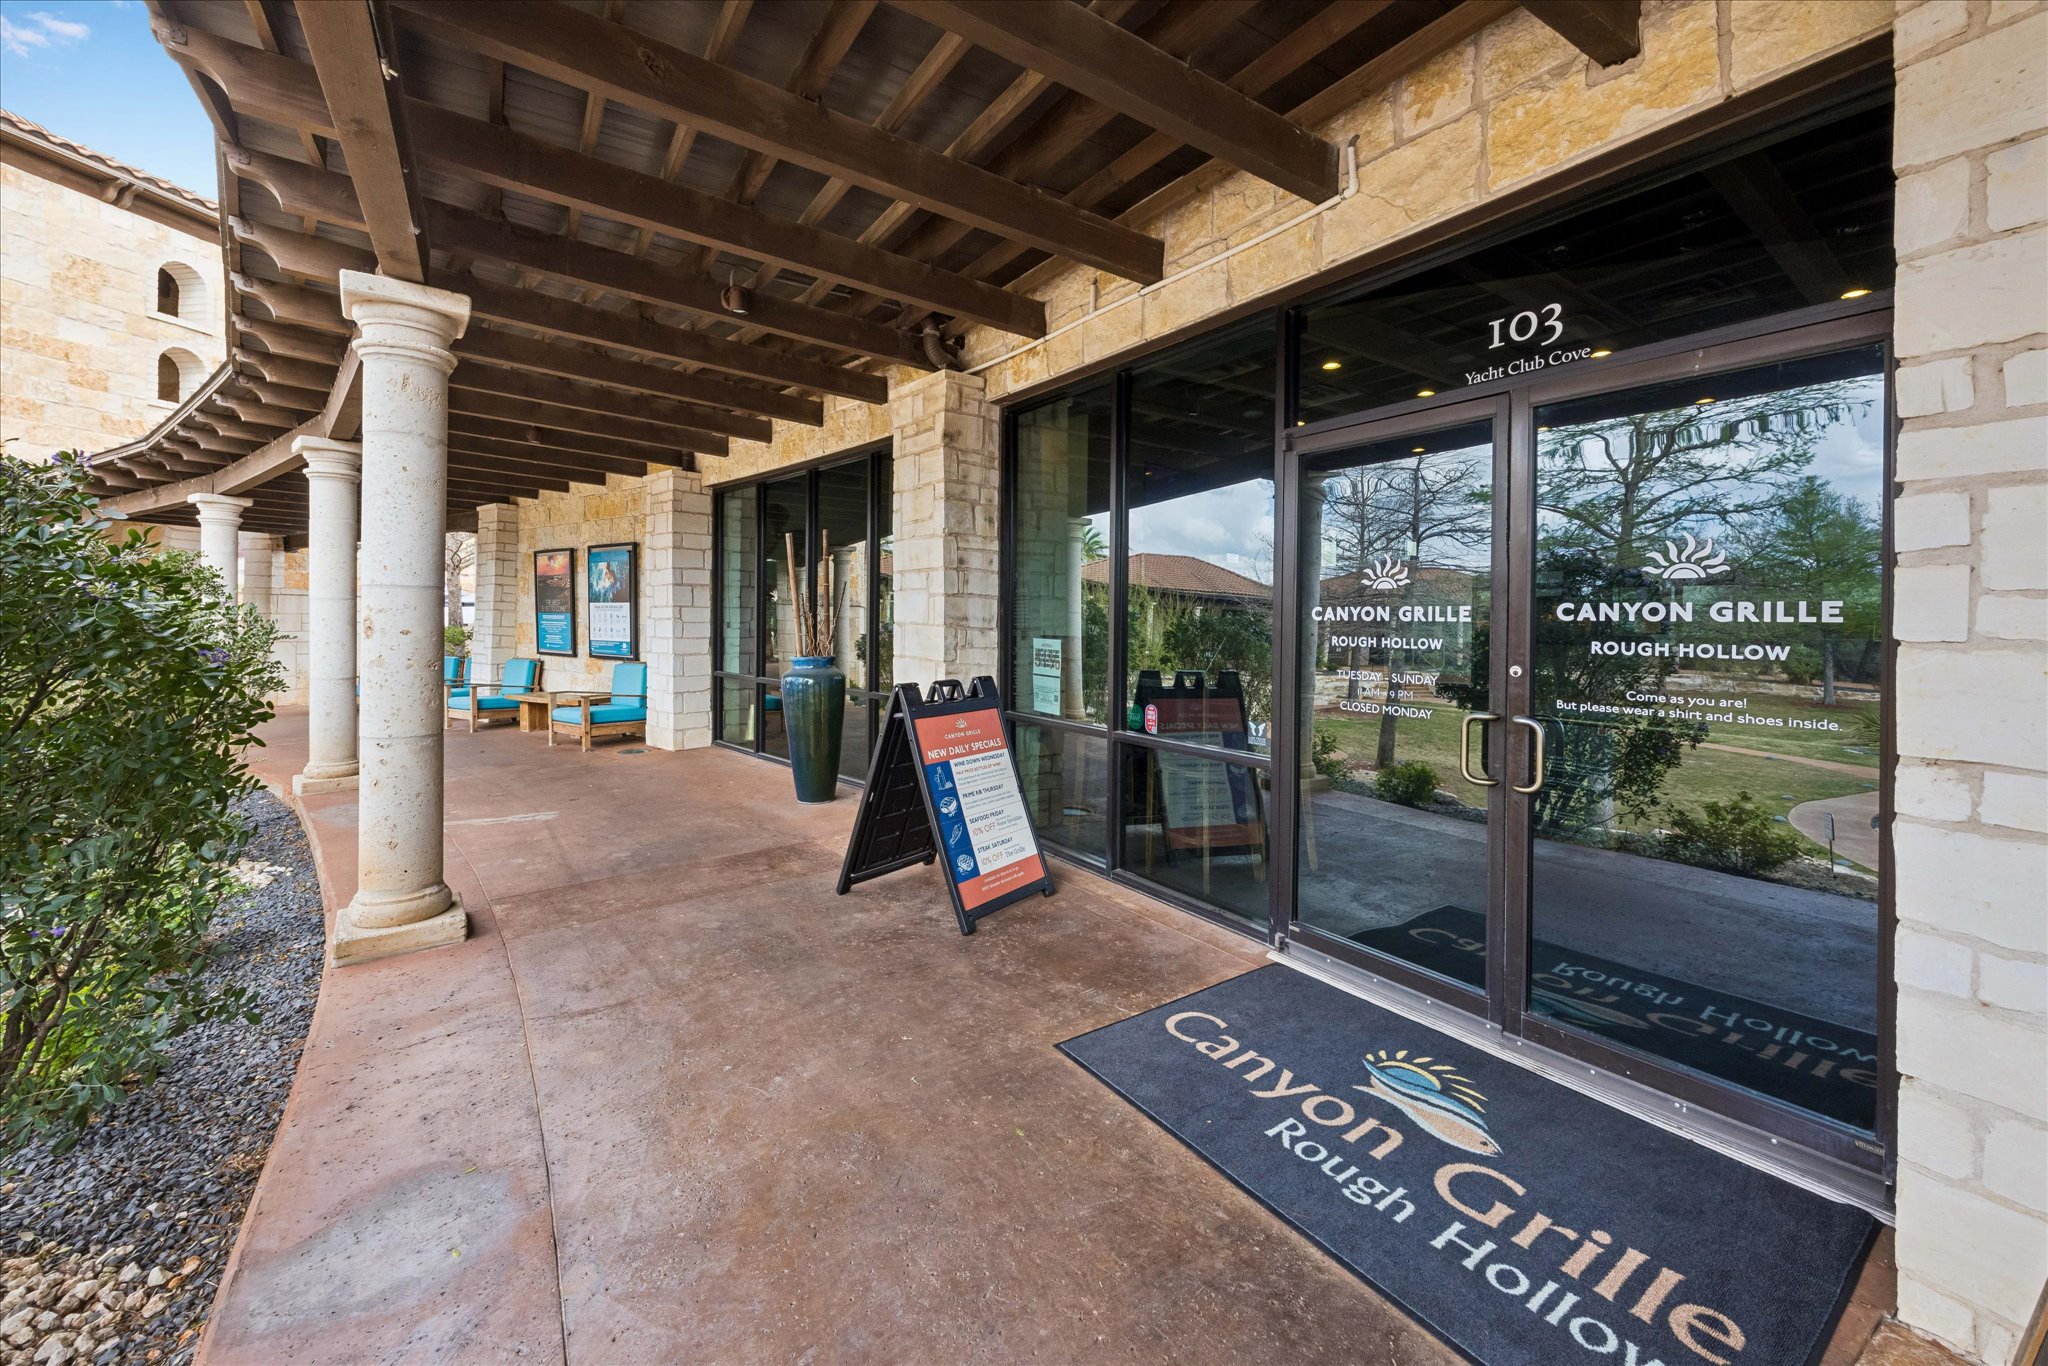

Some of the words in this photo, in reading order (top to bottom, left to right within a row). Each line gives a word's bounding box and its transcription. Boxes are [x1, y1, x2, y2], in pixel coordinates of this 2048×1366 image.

[1488, 302, 1564, 349] 103
[1465, 366, 1505, 385] Yacht
[1507, 355, 1545, 375] Club
[1549, 347, 1591, 366] Cove
[1311, 606, 1390, 622] CANYON
[1398, 605, 1472, 622] GRILLE
[1556, 601, 1693, 622] CANYON
[1709, 601, 1844, 623] GRILLE
[1331, 635, 1377, 648] ROUGH
[1381, 637, 1443, 650] HOLLOW
[1591, 641, 1670, 657] ROUGH
[1679, 643, 1791, 661] HOLLOW
[1337, 669, 1383, 682] TUESDAY
[1391, 673, 1438, 686] SUNDAY
[1397, 690, 1414, 700] PM
[1626, 690, 1666, 703] Come
[1669, 695, 1684, 704] as
[1687, 697, 1714, 708] you
[1719, 698, 1747, 708] are!
[1340, 700, 1380, 713] CLOSED
[1382, 705, 1432, 719] MONDAY
[1556, 700, 1577, 710] But
[1580, 702, 1619, 714] please
[1622, 707, 1655, 716] wear
[1658, 709, 1665, 717] a
[1669, 708, 1702, 720] shirt
[1706, 712, 1732, 722] and
[1737, 713, 1784, 727] shoes
[1788, 717, 1843, 731] inside.
[945, 731, 965, 740] CANYON
[928, 747, 947, 759] NEW
[948, 743, 970, 756] DAILY
[971, 738, 1002, 751] SPECIALS
[962, 791, 975, 799] PRIME
[983, 784, 1004, 793] THURSDAY
[969, 814, 990, 824] SEAFOOD
[984, 821, 997, 832] OFF
[977, 845, 991, 853] STEAK
[991, 837, 1013, 848] SATURDAY
[992, 851, 1004, 861] OFF
[1264, 1117, 1416, 1223] Rough
[1165, 1011, 1404, 1160] Canyon
[1433, 1162, 1747, 1366] Grille
